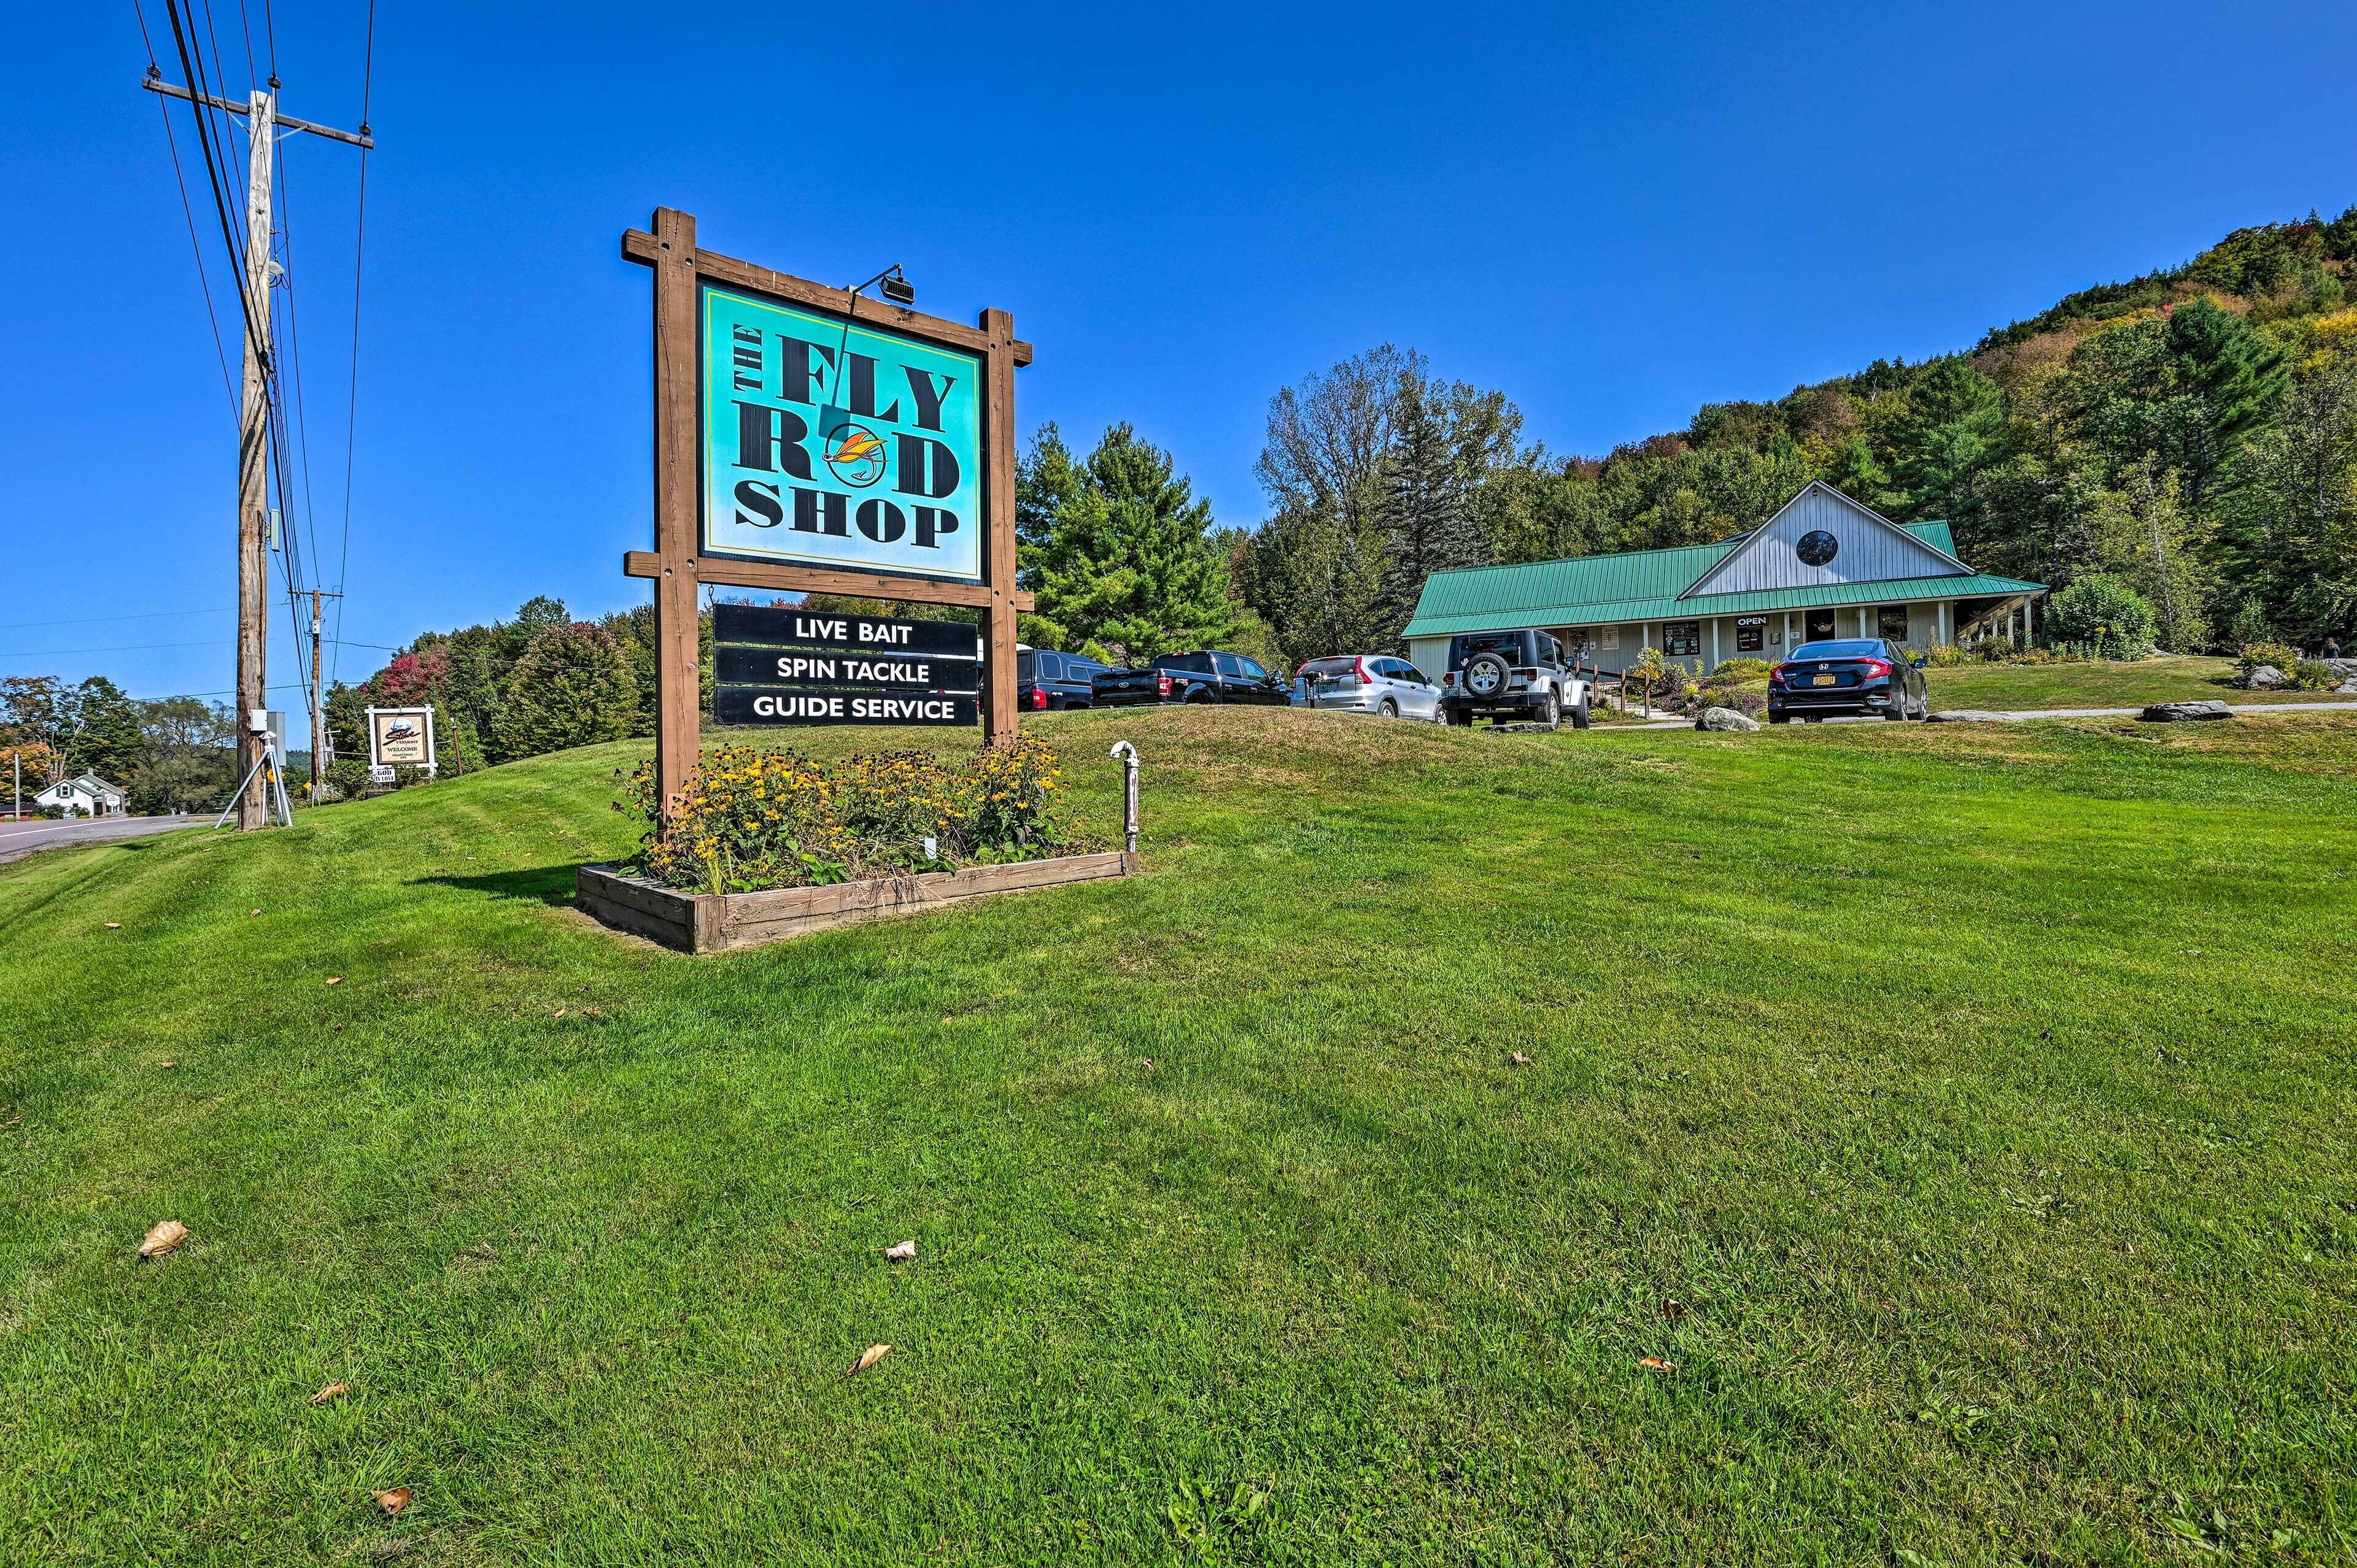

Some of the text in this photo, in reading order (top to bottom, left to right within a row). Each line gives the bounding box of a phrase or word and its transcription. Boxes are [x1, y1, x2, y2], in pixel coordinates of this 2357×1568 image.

[733, 323, 763, 392] THE
[775, 333, 958, 433] FLY
[730, 399, 960, 500] ROD
[733, 480, 959, 549] SHOP
[796, 618, 912, 644] LIVE BAIT
[1738, 617, 1767, 625] OPEN
[777, 657, 929, 682] SPIN TACKLE
[753, 696, 954, 719] GUIDE SERVICE
